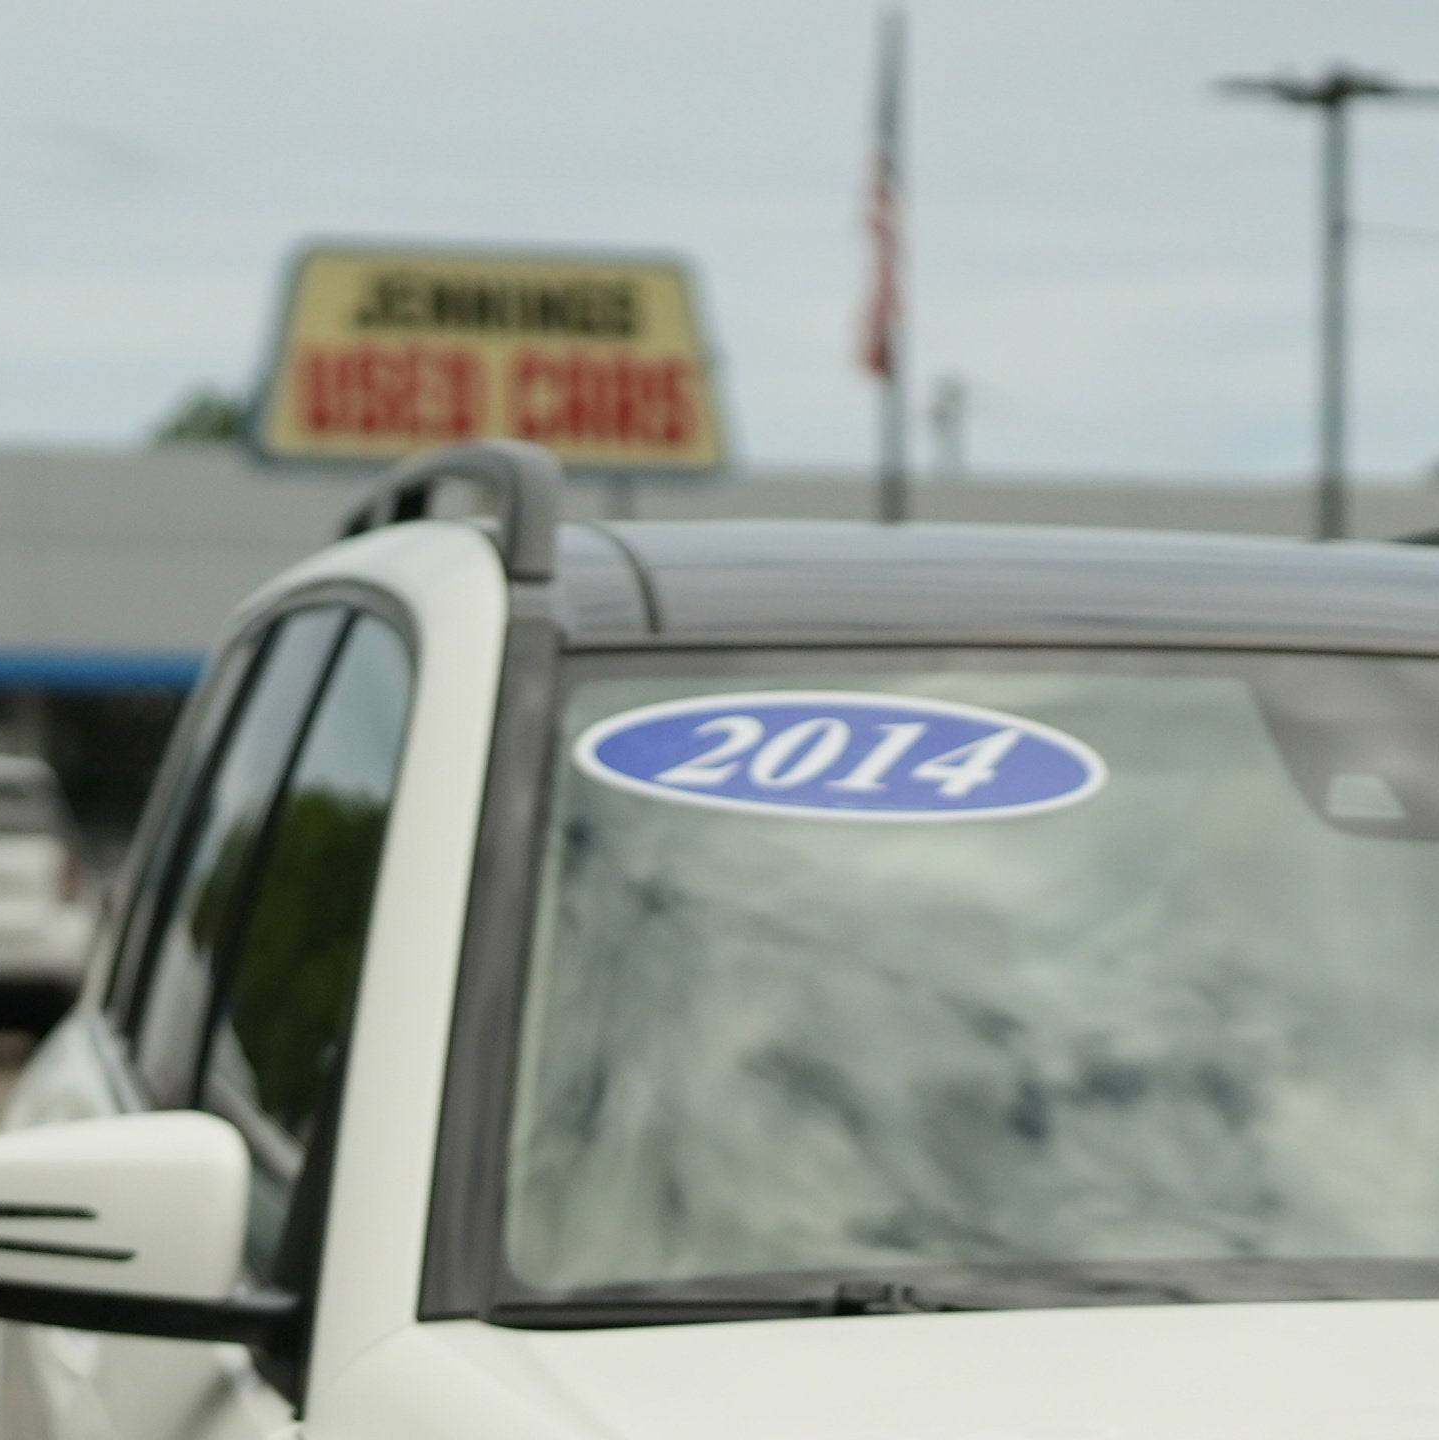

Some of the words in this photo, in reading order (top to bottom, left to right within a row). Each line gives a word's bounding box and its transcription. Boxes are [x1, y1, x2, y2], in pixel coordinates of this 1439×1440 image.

[298, 343, 481, 435] USED
[511, 346, 697, 447] CARS
[654, 714, 1023, 797] 2014
